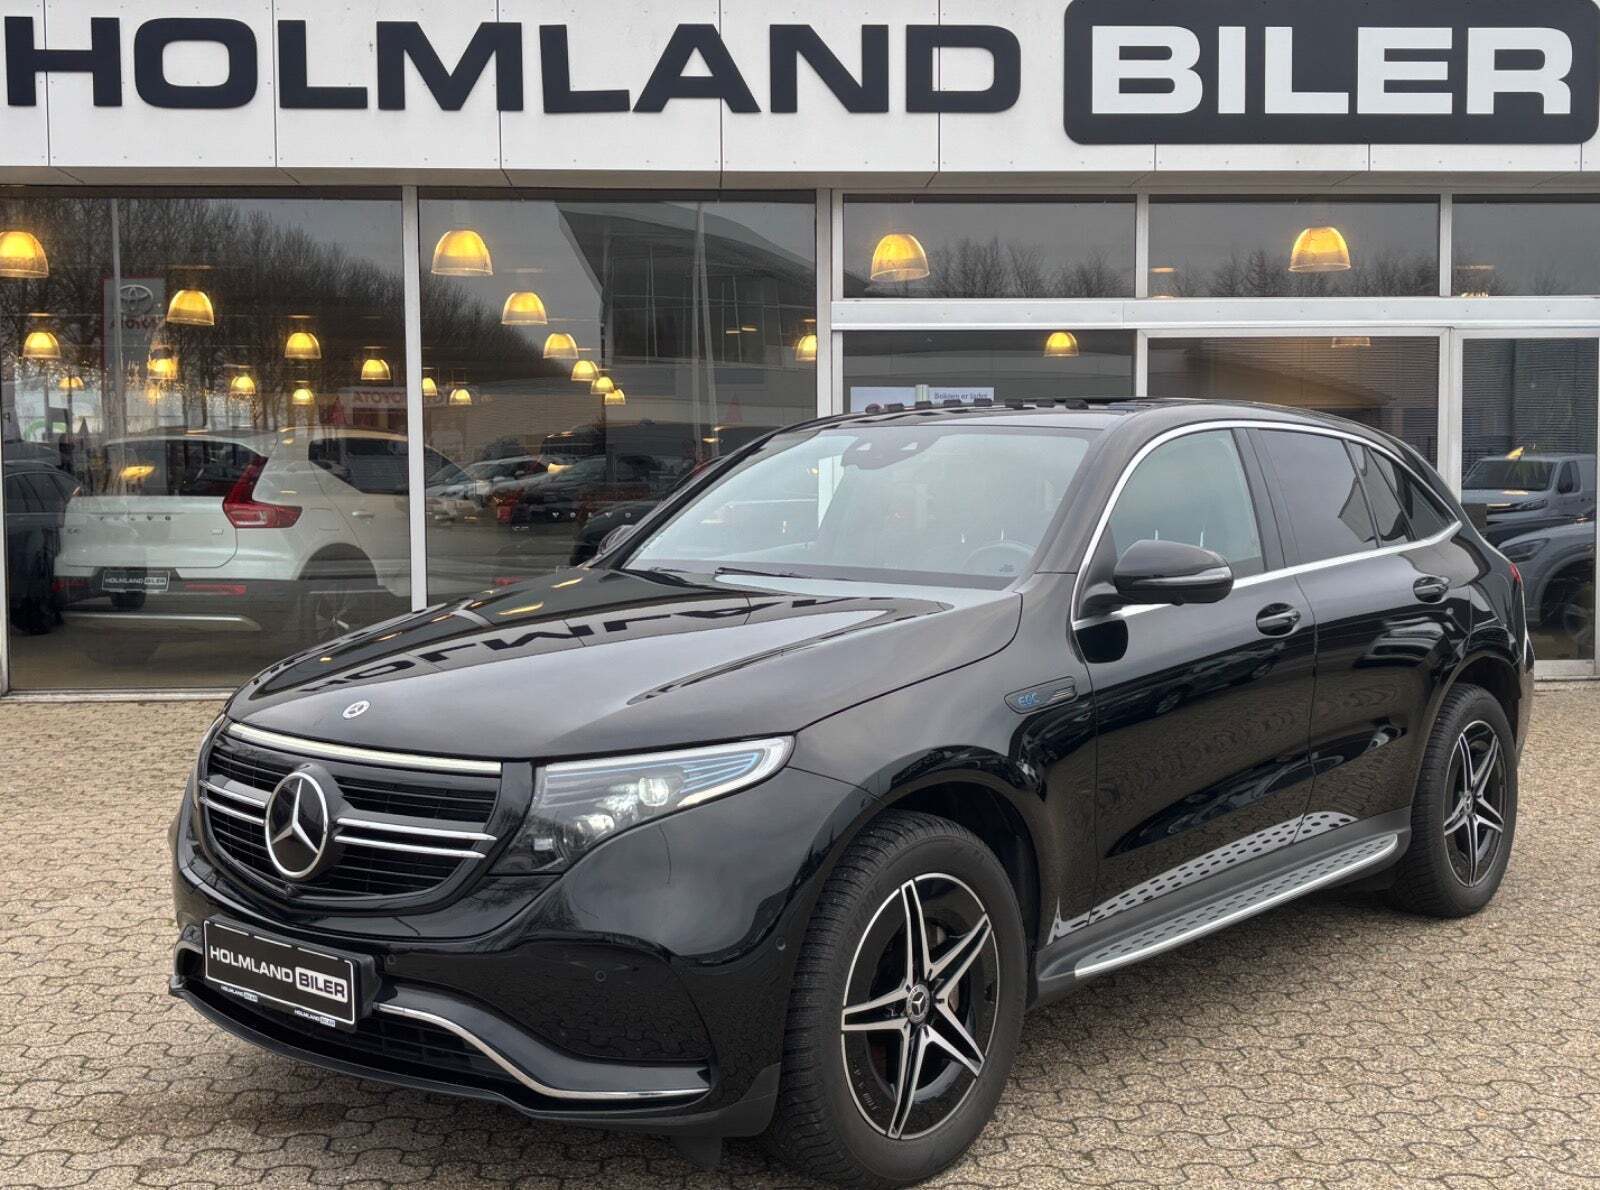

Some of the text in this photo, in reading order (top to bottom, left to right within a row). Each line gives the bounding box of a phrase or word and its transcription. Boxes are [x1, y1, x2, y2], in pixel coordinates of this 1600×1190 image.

[5, 16, 1573, 114] HOLMLAND BILER
[552, 511, 632, 519] VOLVO
[209, 945, 346, 998] HOLMLAND BILER
[294, 1009, 320, 1022] HOLMLAND
